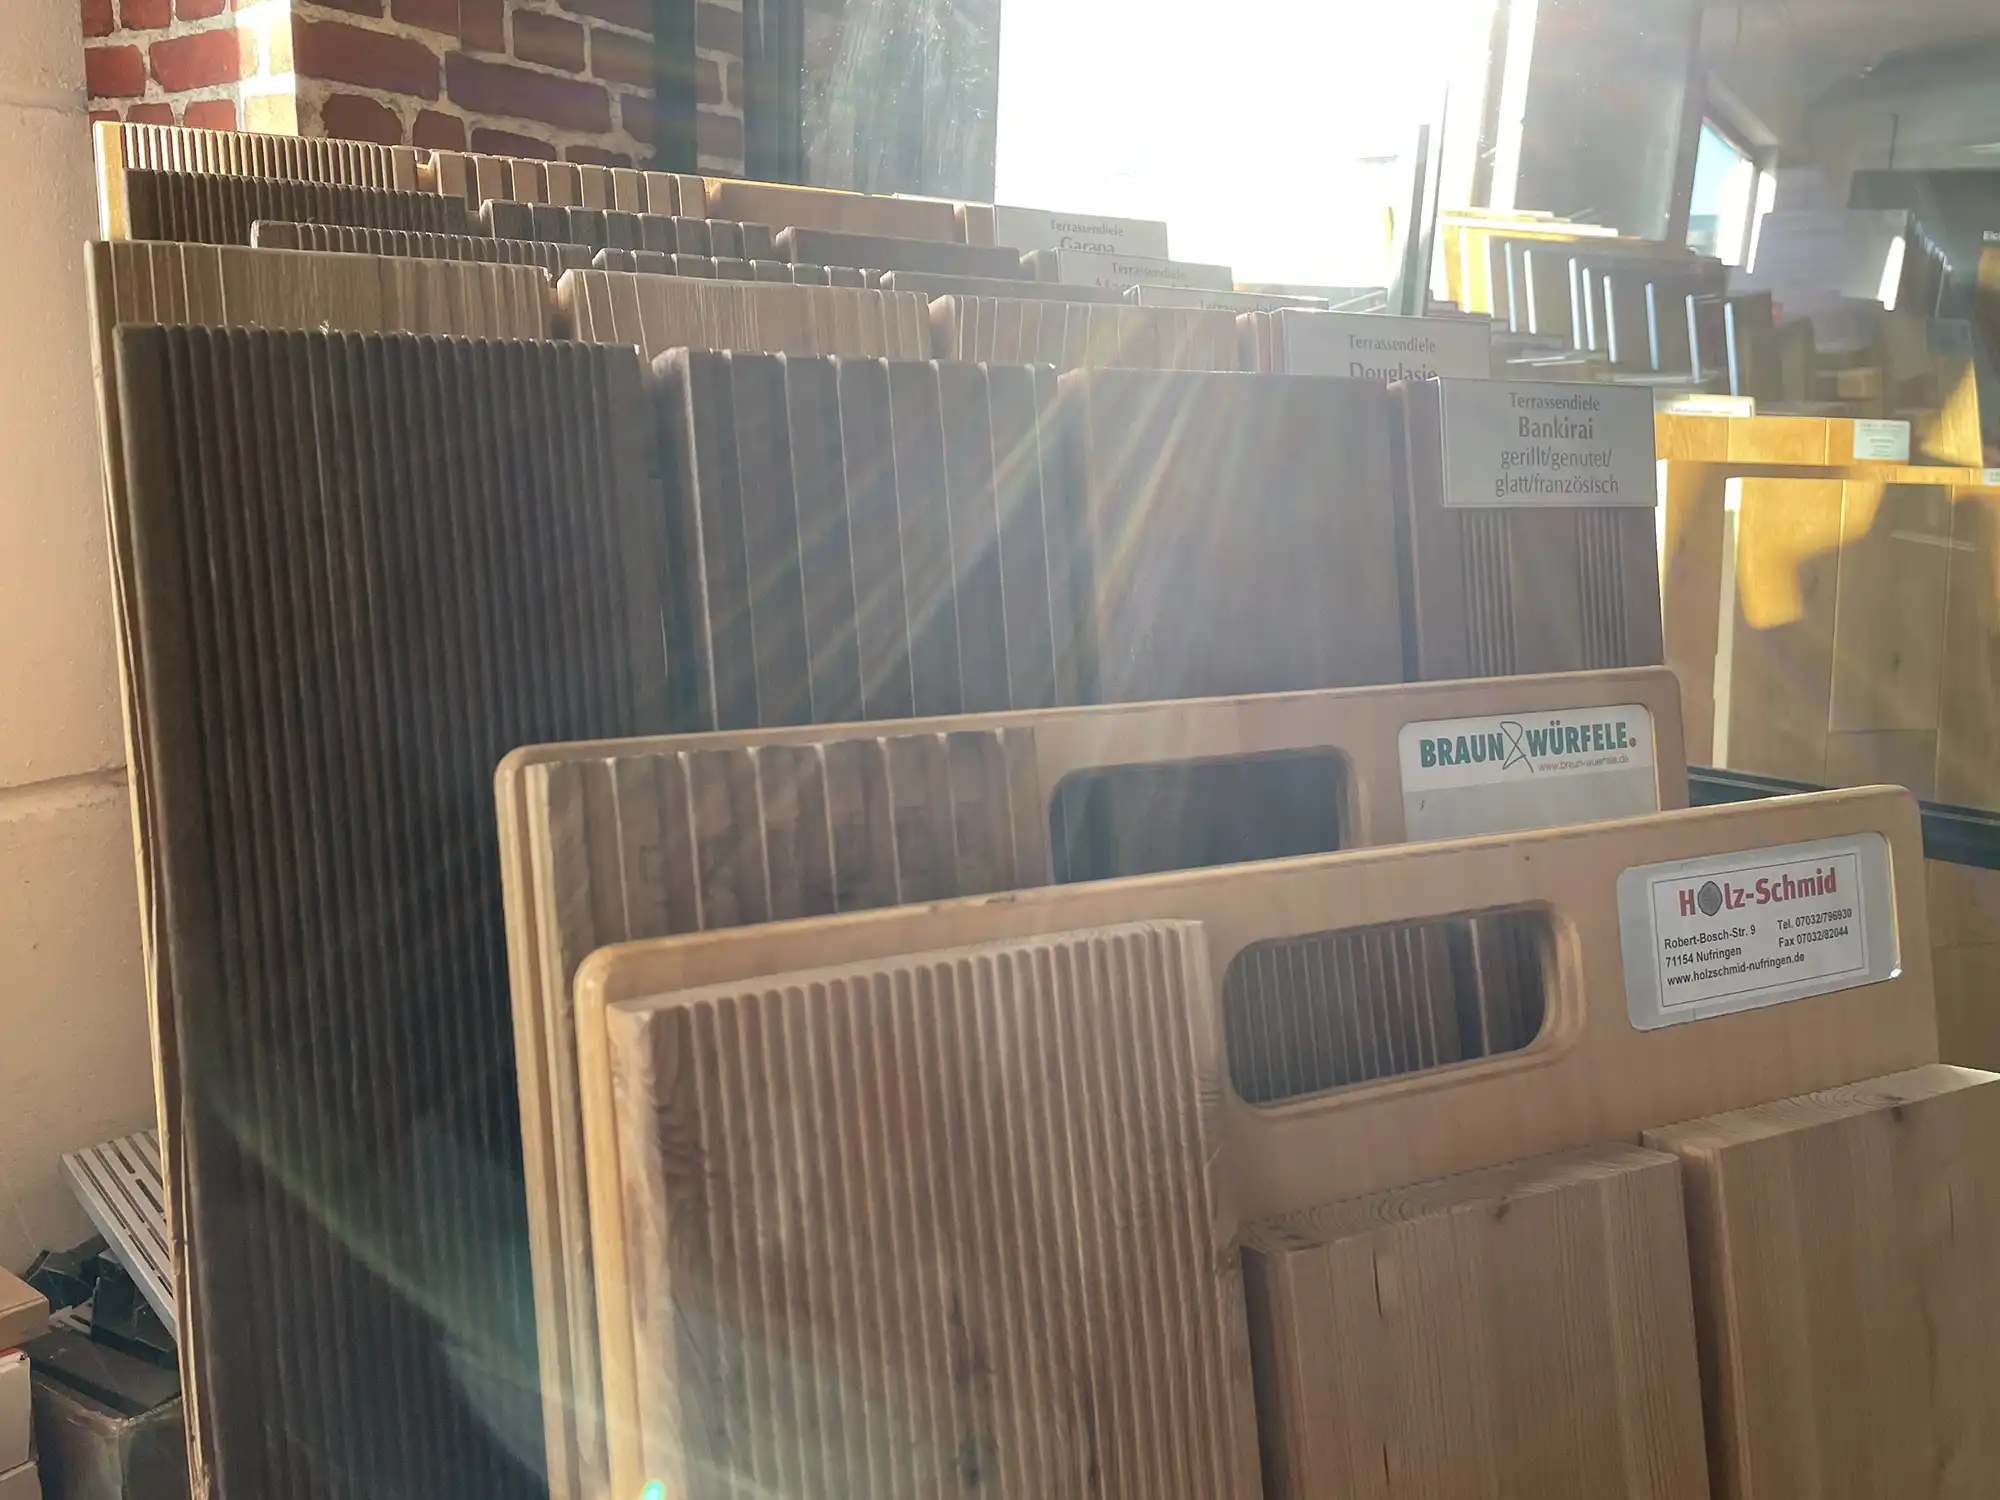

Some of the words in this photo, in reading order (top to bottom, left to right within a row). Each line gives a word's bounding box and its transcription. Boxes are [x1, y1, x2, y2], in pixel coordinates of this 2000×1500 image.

[1051, 219, 1124, 236] Terrassendiele
[1347, 334, 1436, 354] Terrassendiele
[1508, 391, 1601, 411] Terrassendiele
[1518, 414, 1594, 440] Bankirai
[1500, 445, 1613, 471] gerillt/genutet/
[1495, 472, 1619, 498] glatt/französisch
[1419, 732, 1504, 768] BRAUN
[1777, 918, 1794, 931] Tel.
[1795, 908, 1853, 928] 07032/796930
[1664, 926, 1749, 950] Robert-Bosch-Str.
[1749, 924, 1757, 936] 9
[1779, 936, 1795, 948] Fax
[1796, 926, 1849, 945] 07032/82044
[1665, 952, 1694, 968] 71154
[1696, 947, 1742, 963] Nufringen
[1667, 951, 1806, 986] www.holzschmid-nufringen.de
